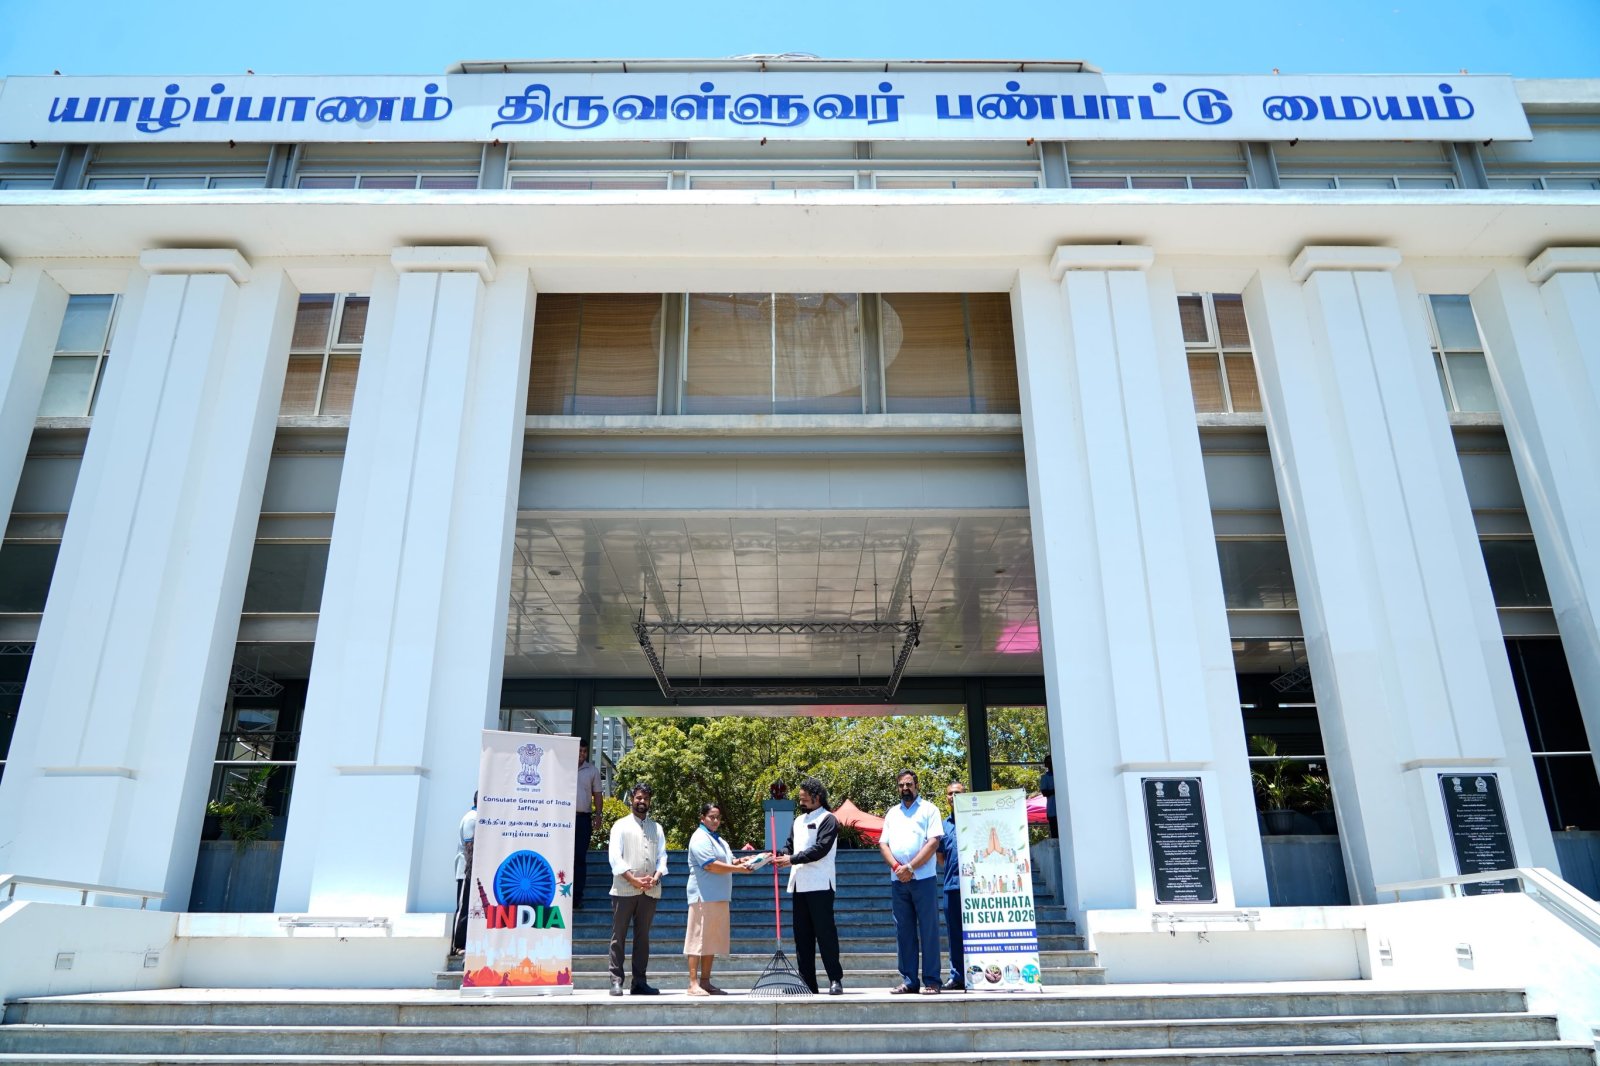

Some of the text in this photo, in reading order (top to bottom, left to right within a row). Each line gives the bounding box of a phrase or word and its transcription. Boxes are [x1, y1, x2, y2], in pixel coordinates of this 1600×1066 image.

[48, 80, 1475, 133] யாழ்ப்பாணம் திருவள்ளுவர் பண்பாட்டு மையம்
[965, 896, 1031, 910] SWACHHATA
[486, 904, 565, 929] INDIA
[963, 910, 1034, 924] HI SEVA 2026
